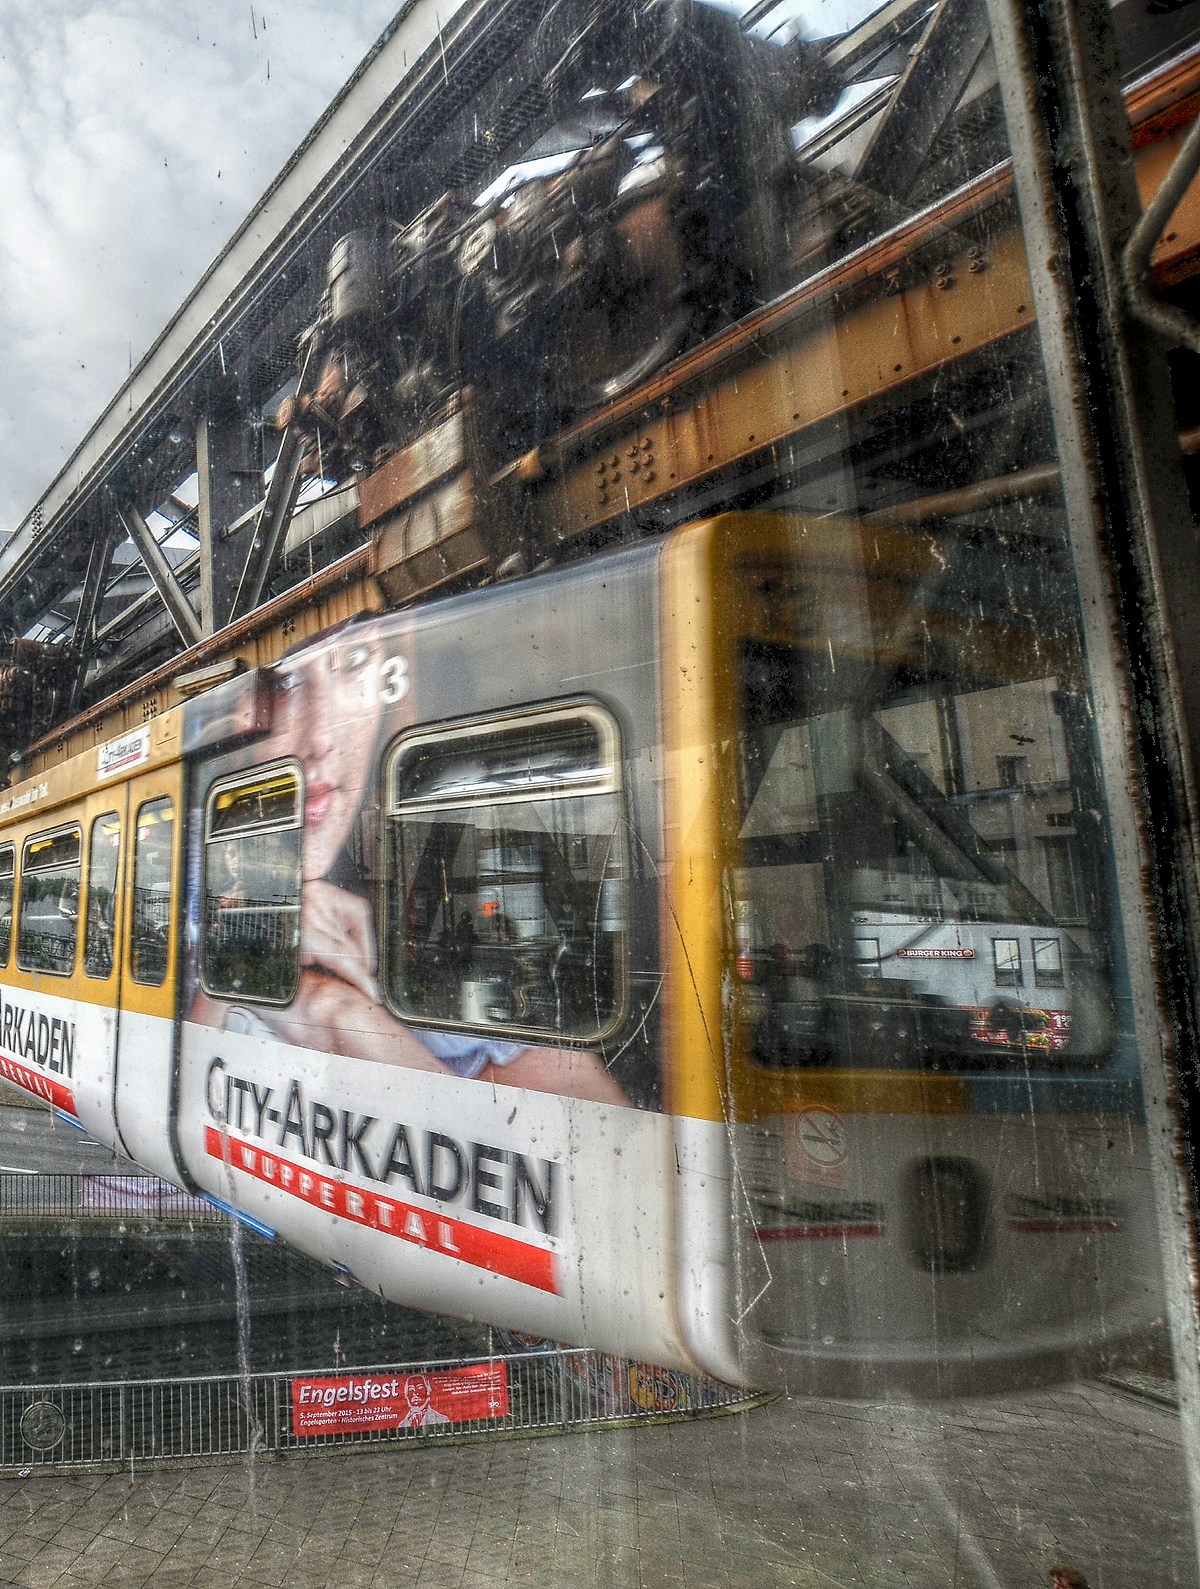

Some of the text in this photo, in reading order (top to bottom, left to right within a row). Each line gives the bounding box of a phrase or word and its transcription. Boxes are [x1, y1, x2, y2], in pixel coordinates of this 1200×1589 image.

[204, 1056, 563, 1238] CITY-ARKADEN
[240, 1145, 460, 1253] WUPPERTAL
[299, 1379, 399, 1407] Engelsfest
[300, 1412, 398, 1427] Engelsgarten Historisches Zentrum
[306, 1410, 337, 1419] September
[338, 1409, 352, 1417] 2015
